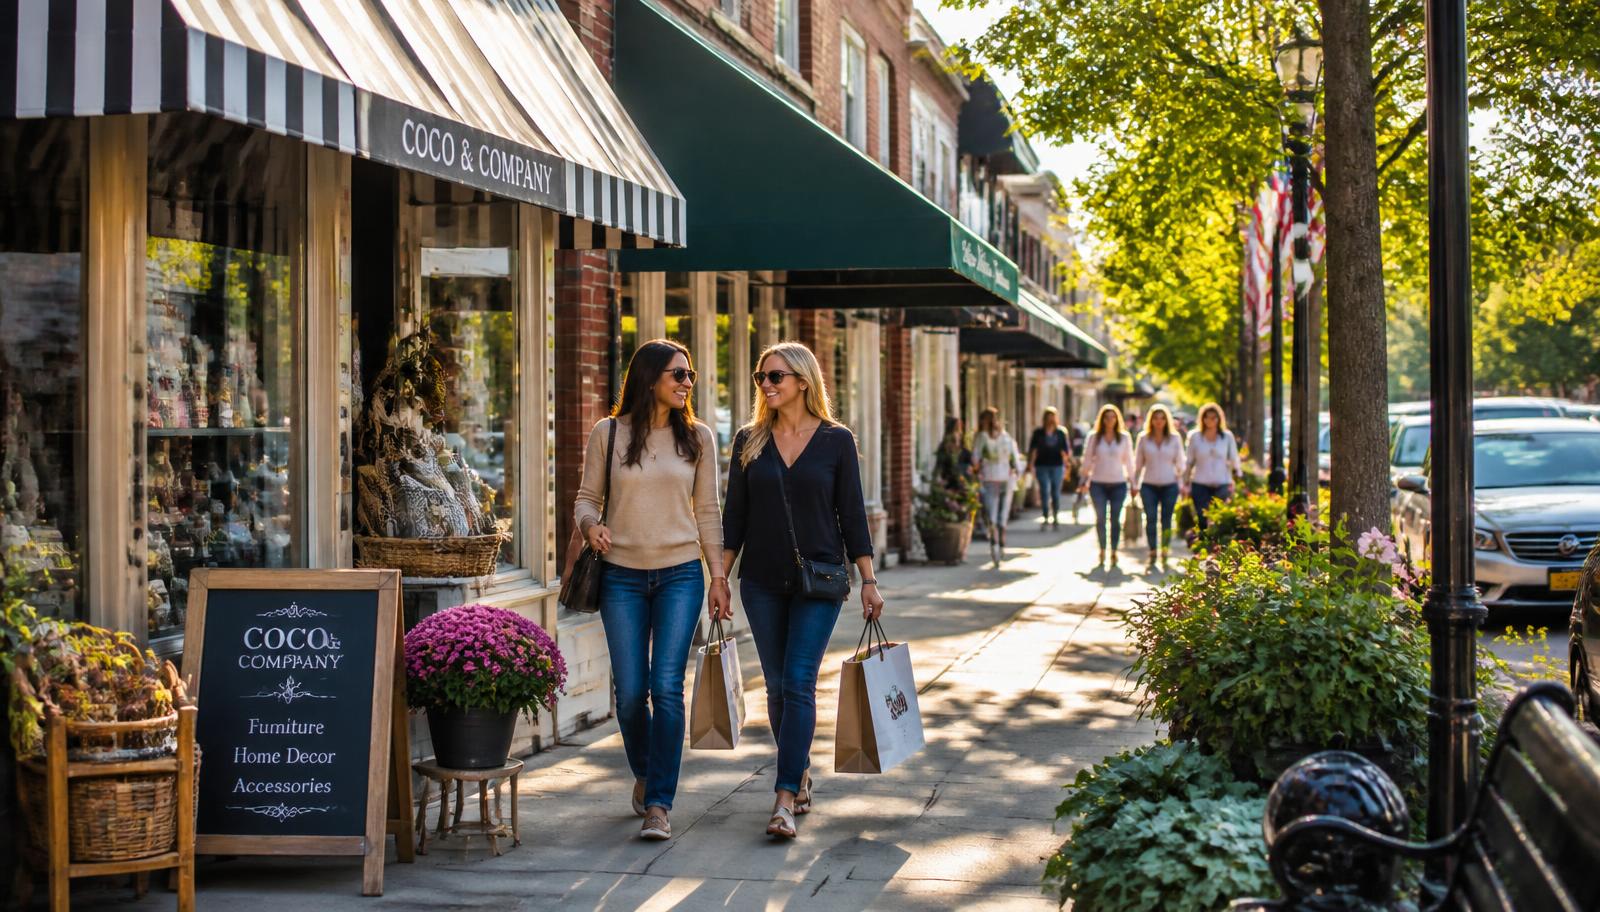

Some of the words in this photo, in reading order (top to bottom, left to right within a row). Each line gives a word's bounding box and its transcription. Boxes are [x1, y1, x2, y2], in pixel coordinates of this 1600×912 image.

[402, 119, 455, 166] COCO
[460, 138, 474, 172] &
[479, 144, 552, 195] COMPANY
[234, 747, 281, 764] Home
[286, 747, 336, 764] Decor
[232, 777, 332, 793] Accessories
